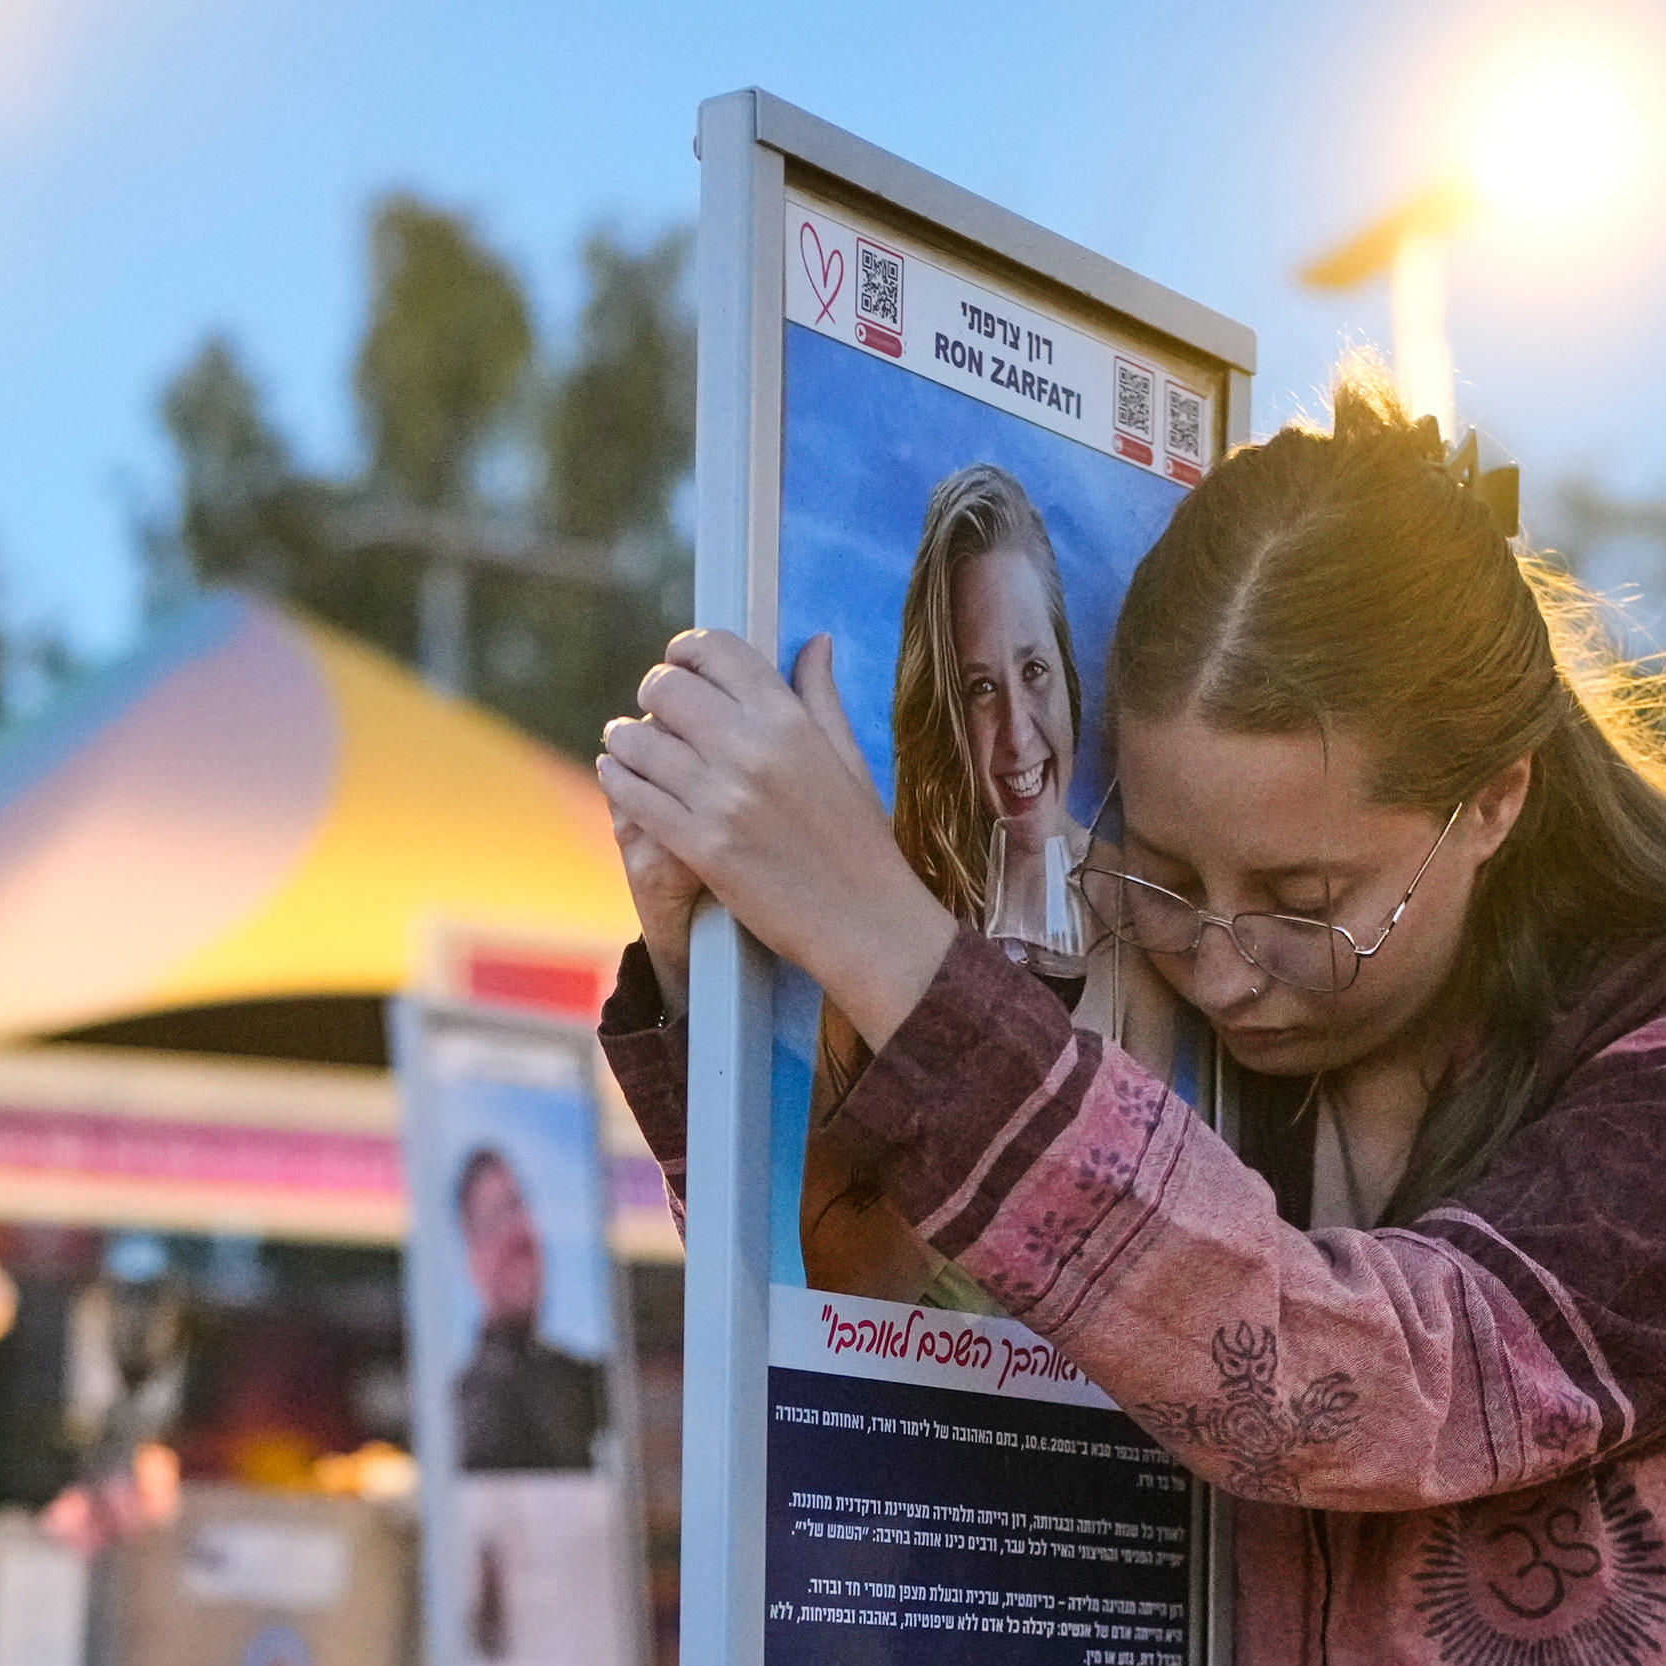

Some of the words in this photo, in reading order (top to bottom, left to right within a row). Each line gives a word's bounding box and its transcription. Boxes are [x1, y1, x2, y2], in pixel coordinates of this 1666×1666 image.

[960, 300, 1021, 351] צרפתי
[1027, 330, 1053, 365] רון
[934, 331, 983, 378] RON
[989, 355, 1082, 419] ZARFATI
[916, 1328, 993, 1369] השכם
[775, 1404, 819, 1425] הבכורה
[822, 1410, 864, 1430] ואחותם
[867, 1416, 896, 1434] וארז,
[899, 1418, 930, 1438] לימור
[932, 1420, 949, 1440] של
[951, 1425, 993, 1445] האהובה
[995, 1431, 1018, 1448] בתם
[788, 1491, 832, 1511] מחוננת.
[835, 1495, 881, 1517] ורקדנית
[884, 1500, 930, 1520] מצטיינת
[932, 1504, 974, 1524] תלמידה
[976, 1509, 1008, 1527] הייתה
[1011, 1512, 1026, 1530] רון
[1028, 1514, 1074, 1533] ובגרותה,
[872, 1527, 911, 1545] בחיבה:
[913, 1530, 941, 1548] אותה
[944, 1533, 965, 1550] כינו
[967, 1535, 997, 1552] ורבים
[999, 1538, 1025, 1556] עבר,
[1027, 1537, 1047, 1557] לכל
[807, 1578, 841, 1596] וברור.
[844, 1580, 860, 1597] חד
[863, 1582, 896, 1599] מוסרי
[898, 1584, 926, 1603] מצפן
[928, 1583, 963, 1603] ובעלת
[965, 1589, 999, 1606] ערכית
[1001, 1591, 1055, 1610] כריזמטית,
[769, 1600, 793, 1621] ללא
[796, 1605, 855, 1624] ובפתיחות,
[858, 1609, 897, 1627] באהבה
[900, 1612, 954, 1630] שיפוטיות,
[956, 1612, 978, 1632] ללא
[981, 1617, 1003, 1633] אדם
[1005, 1615, 1020, 1634] כל
[1021, 1616, 1055, 1639] קיבלה
